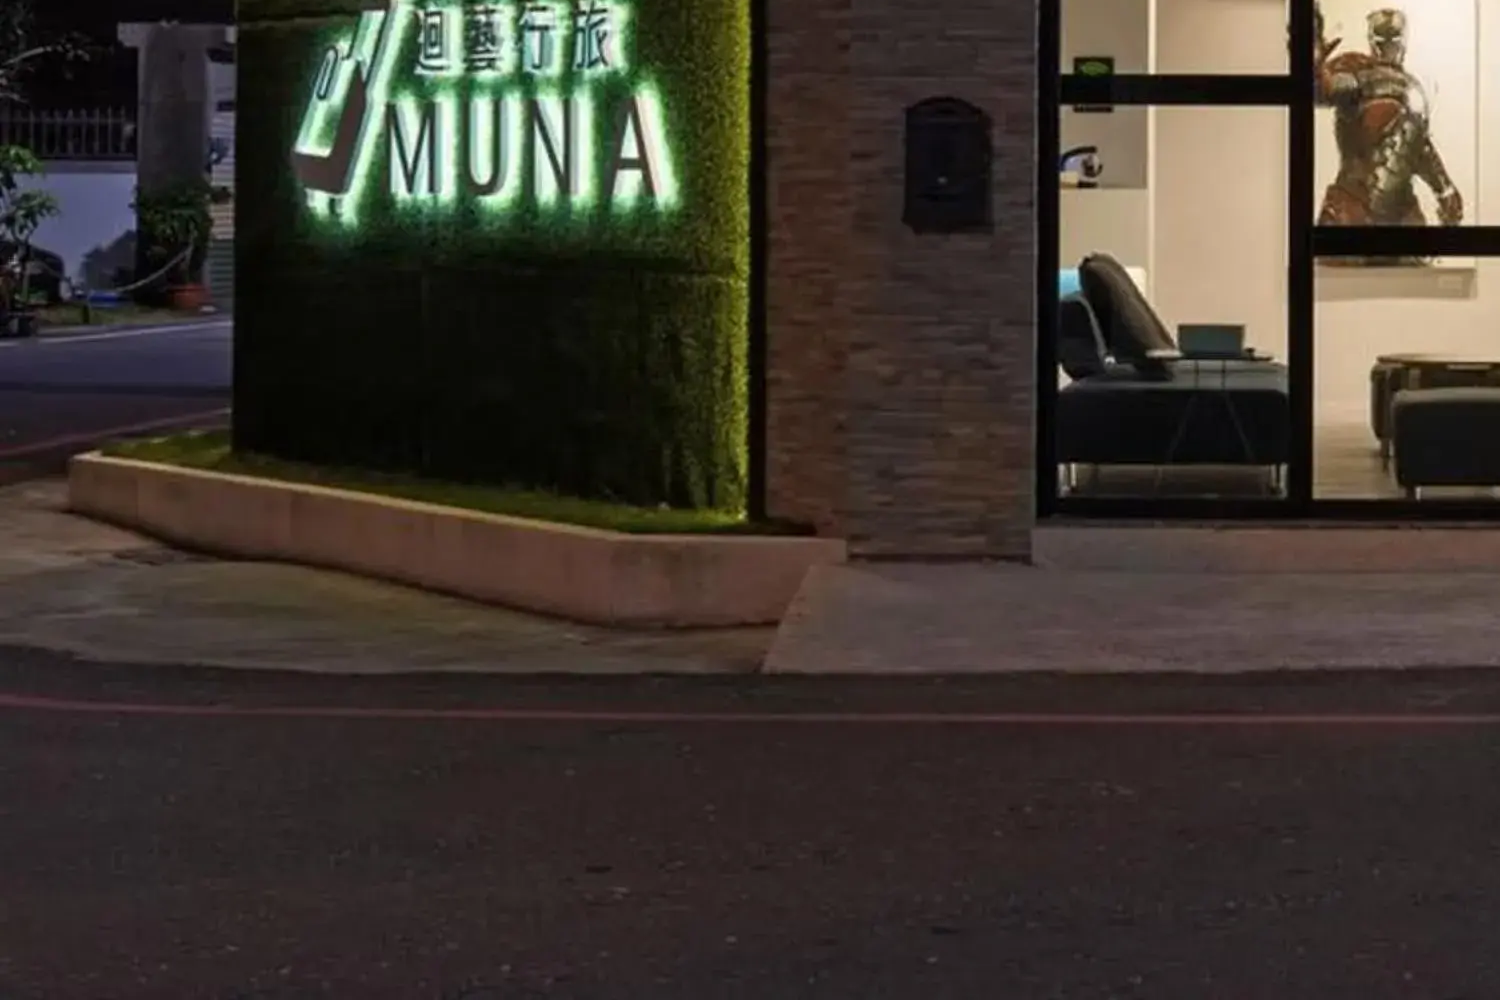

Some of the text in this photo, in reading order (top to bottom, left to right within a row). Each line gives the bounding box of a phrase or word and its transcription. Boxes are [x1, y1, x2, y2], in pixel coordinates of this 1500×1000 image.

[413, 0, 612, 71] 迴藝行旅
[388, 96, 666, 198] MUNA
